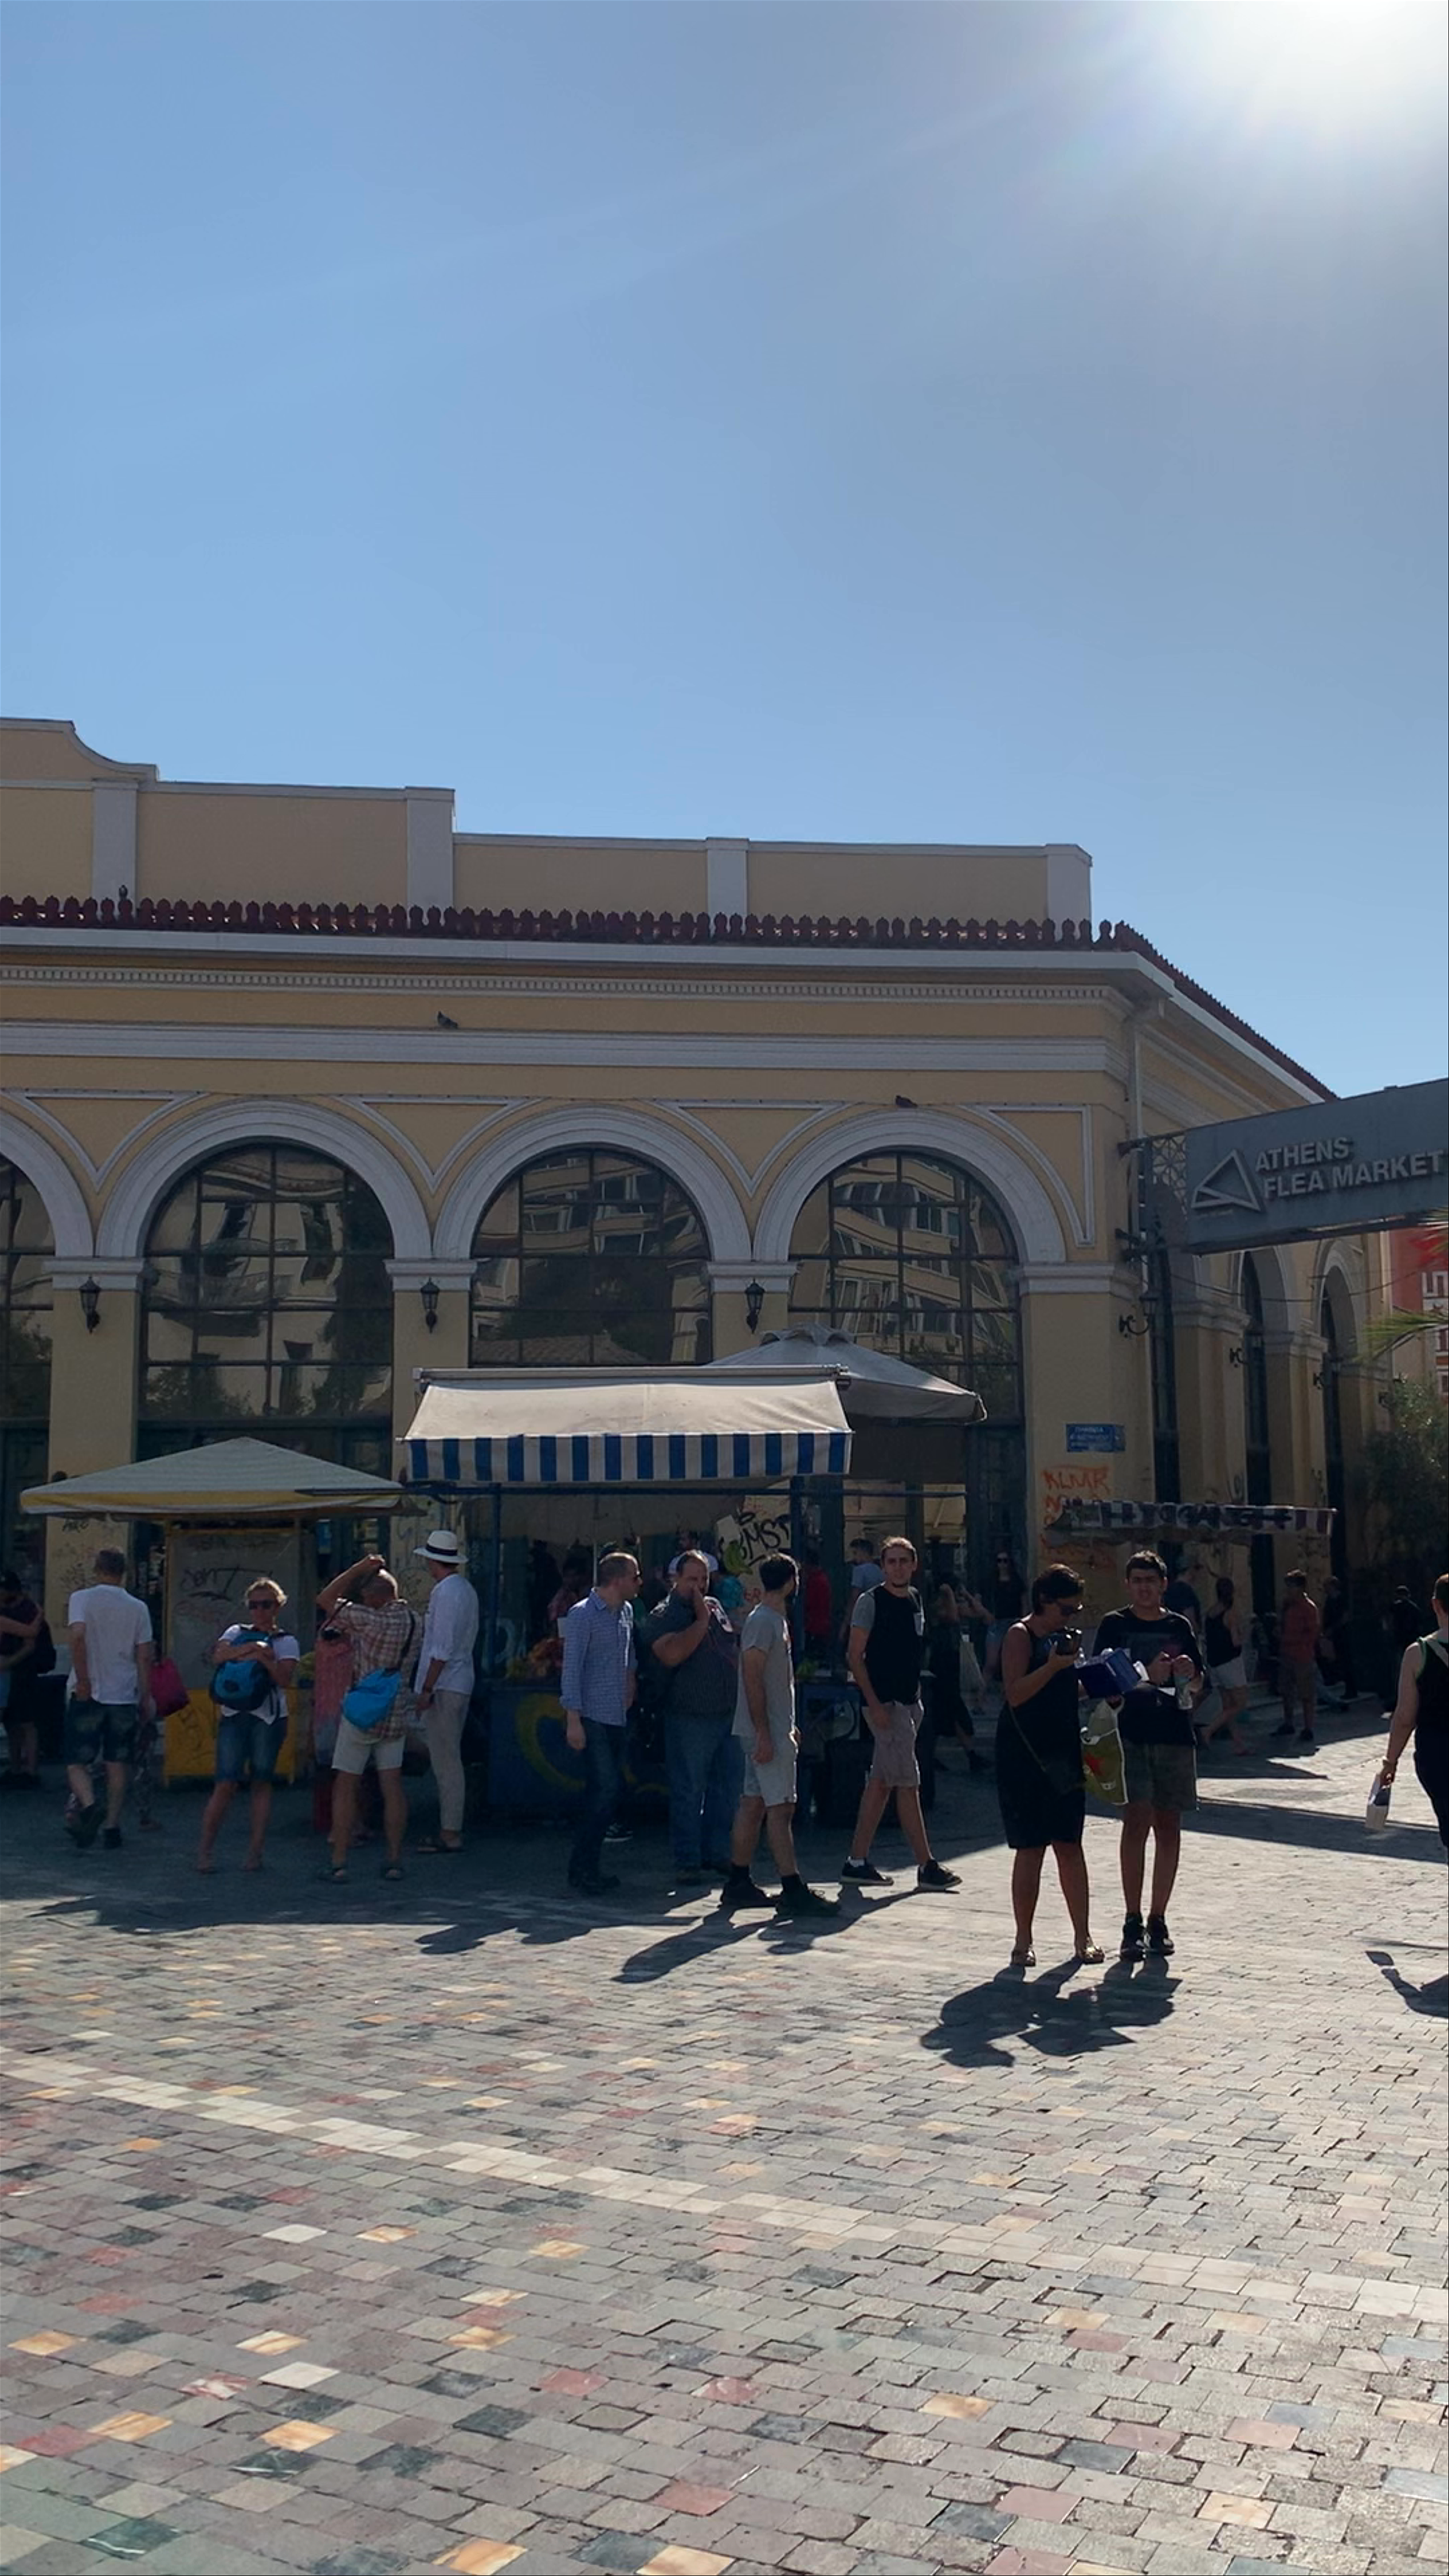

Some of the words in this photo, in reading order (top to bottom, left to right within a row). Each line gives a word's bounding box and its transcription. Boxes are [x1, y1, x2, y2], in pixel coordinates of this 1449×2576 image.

[1255, 1137, 1349, 1172] ATHENS
[1264, 1170, 1324, 1198] FLEA
[1332, 1149, 1444, 1188] MARKET
